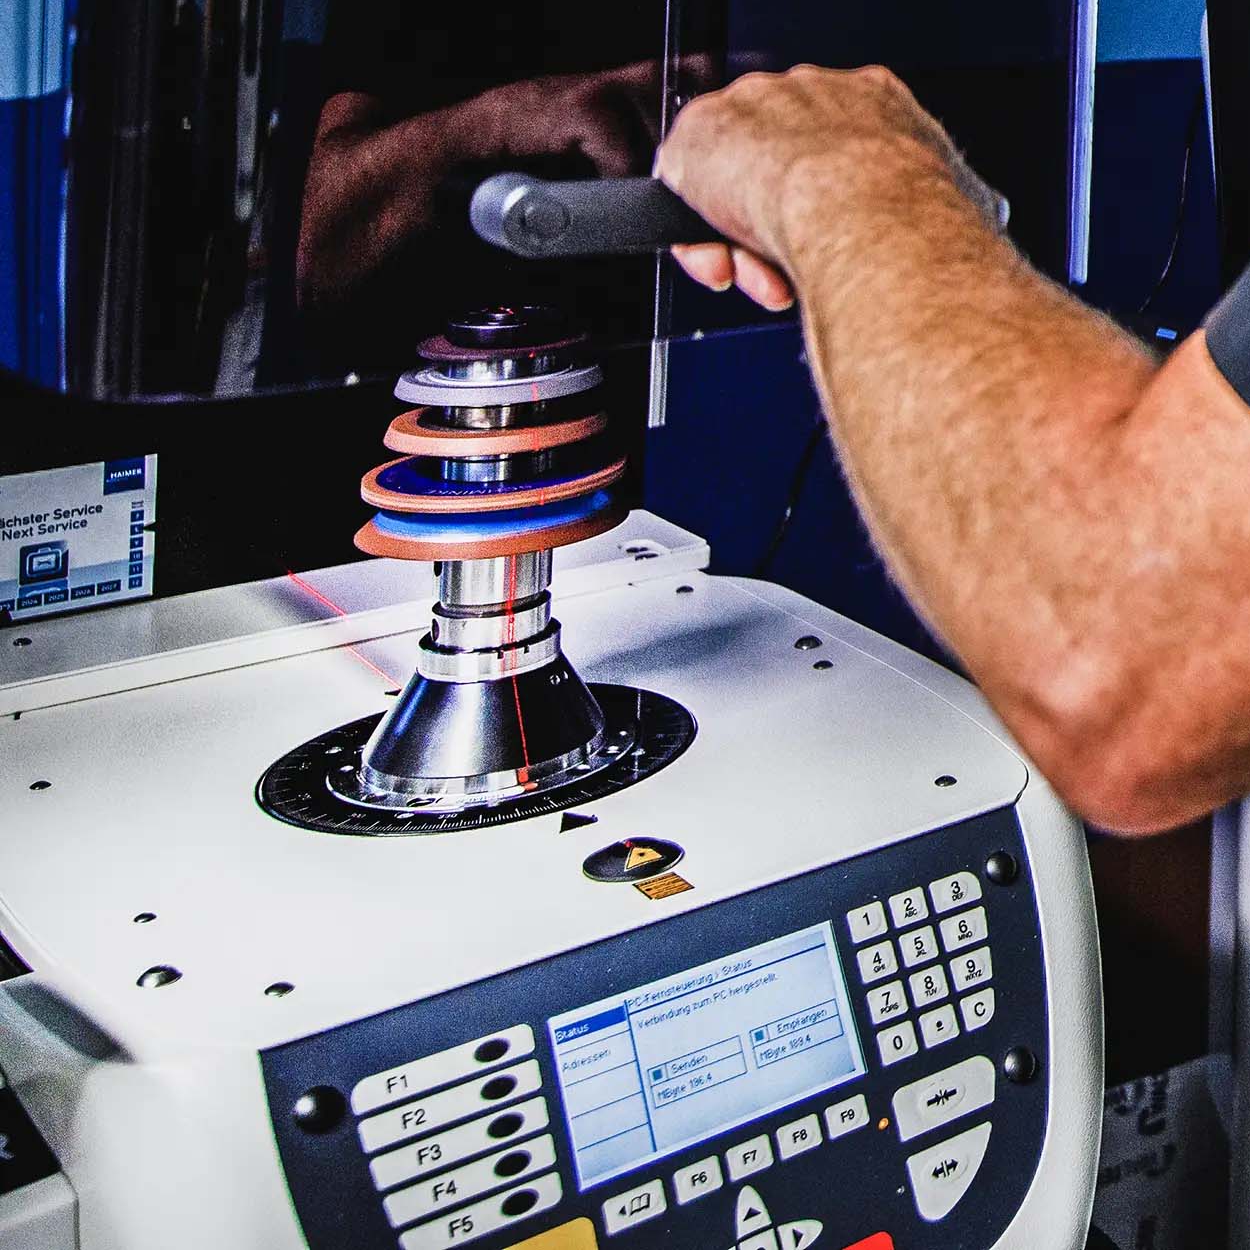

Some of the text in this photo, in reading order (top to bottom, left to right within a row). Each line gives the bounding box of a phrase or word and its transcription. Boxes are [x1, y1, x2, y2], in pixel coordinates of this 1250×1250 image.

[53, 503, 104, 520] Service
[2, 518, 88, 541] Next Service
[951, 880, 961, 895] 3
[904, 897, 914, 911] 2
[952, 892, 964, 901] DEF
[862, 913, 870, 926] 1
[904, 909, 918, 918] ABC
[958, 919, 968, 933] 6
[914, 936, 924, 951] 5
[873, 951, 882, 965] 4
[721, 959, 752, 975] Status
[966, 959, 976, 974] 9
[924, 975, 934, 989] 8
[713, 989, 728, 1004] PC
[881, 991, 891, 1006] 7
[974, 1002, 986, 1017] C
[555, 1023, 590, 1041] Status
[893, 1035, 903, 1050] 0
[671, 1054, 708, 1073] Senden
[386, 1075, 408, 1093] F1
[402, 1108, 426, 1129] F2
[841, 1108, 855, 1124] F9
[792, 1129, 808, 1144] F8
[417, 1144, 442, 1165] F3
[743, 1150, 758, 1164] F7
[691, 1171, 708, 1187] F6
[432, 1180, 457, 1202] F4
[448, 1215, 474, 1238] F5
